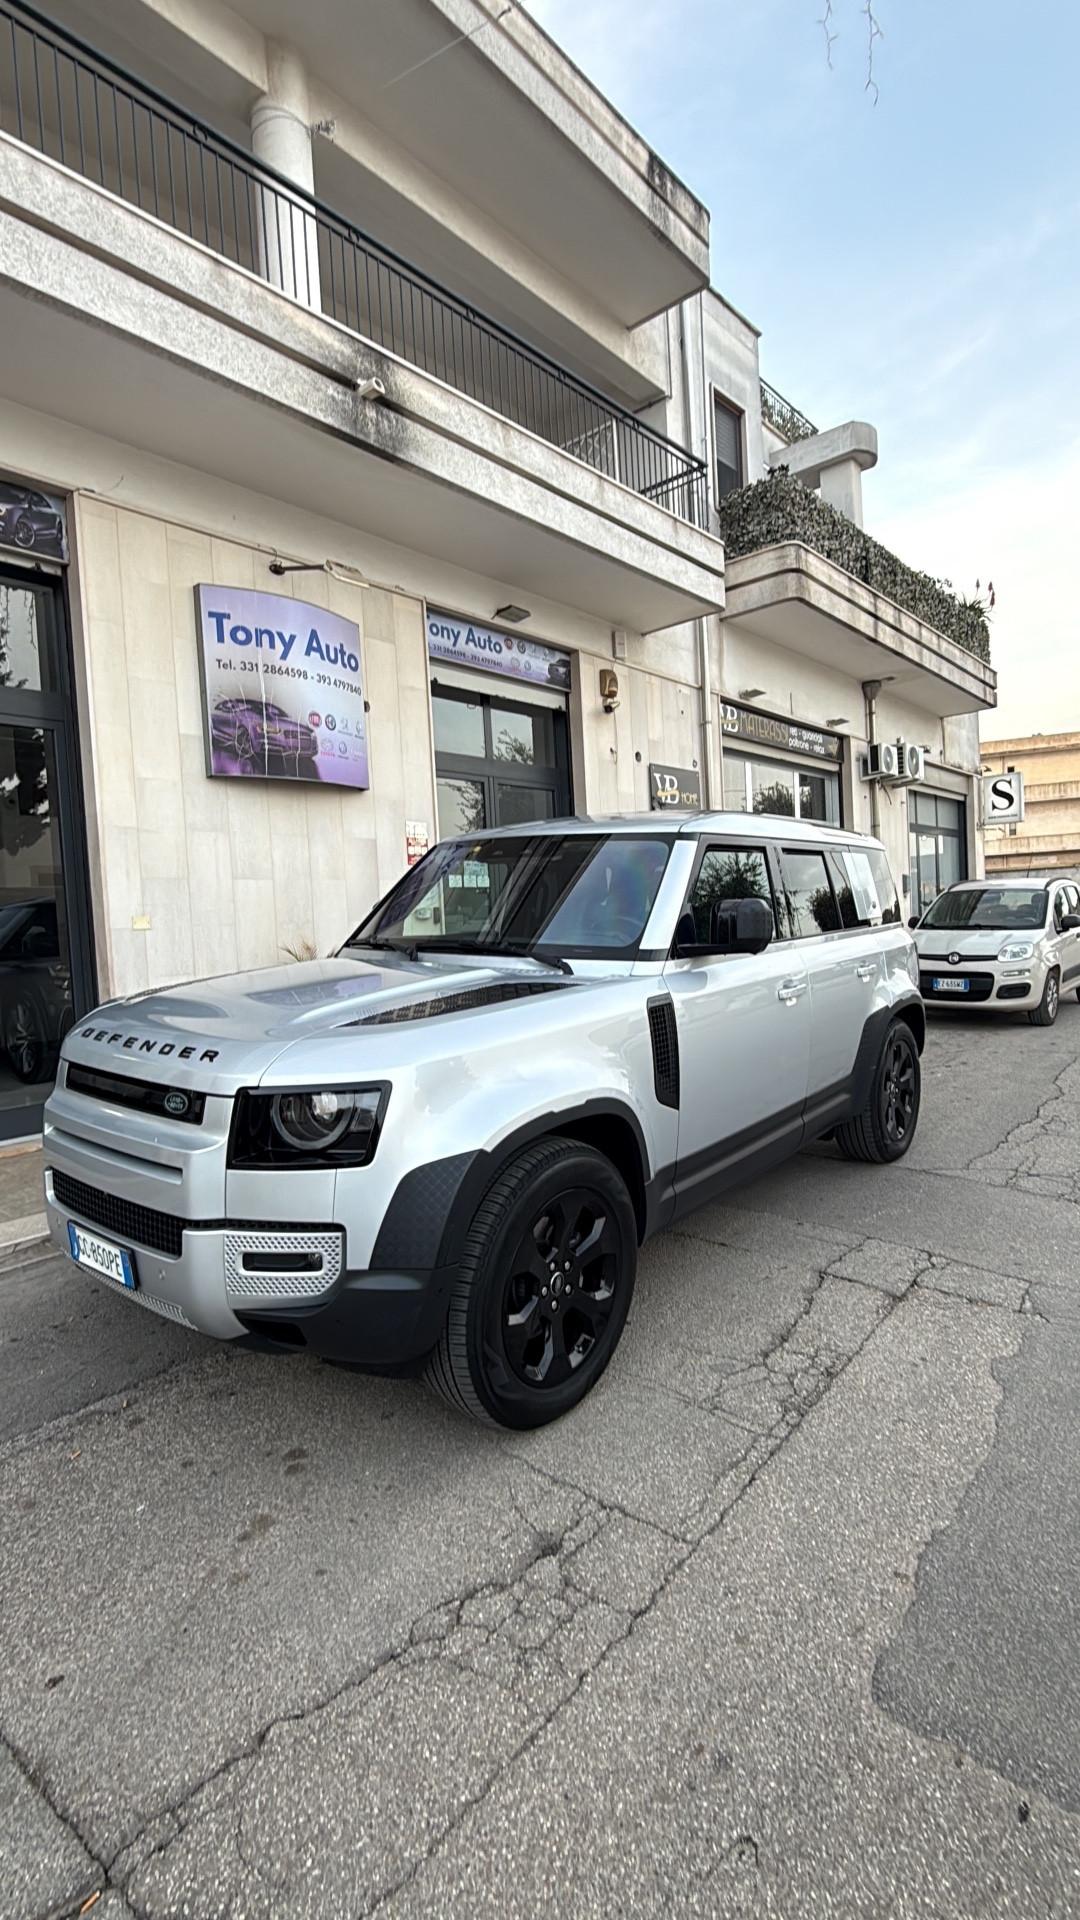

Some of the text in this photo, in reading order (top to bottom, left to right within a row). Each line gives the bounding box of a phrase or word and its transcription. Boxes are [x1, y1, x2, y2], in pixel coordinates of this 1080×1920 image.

[208, 611, 359, 672] Tony Auto
[429, 622, 503, 654] ony Auto
[216, 658, 236, 670] Tel.
[240, 661, 259, 673] 331
[263, 663, 308, 680] 2864598
[316, 673, 332, 686] 393
[333, 678, 362, 696] 4797840
[740, 711, 789, 744] MATERASSI
[991, 777, 1015, 812] S
[81, 1027, 220, 1063] DEFENDER
